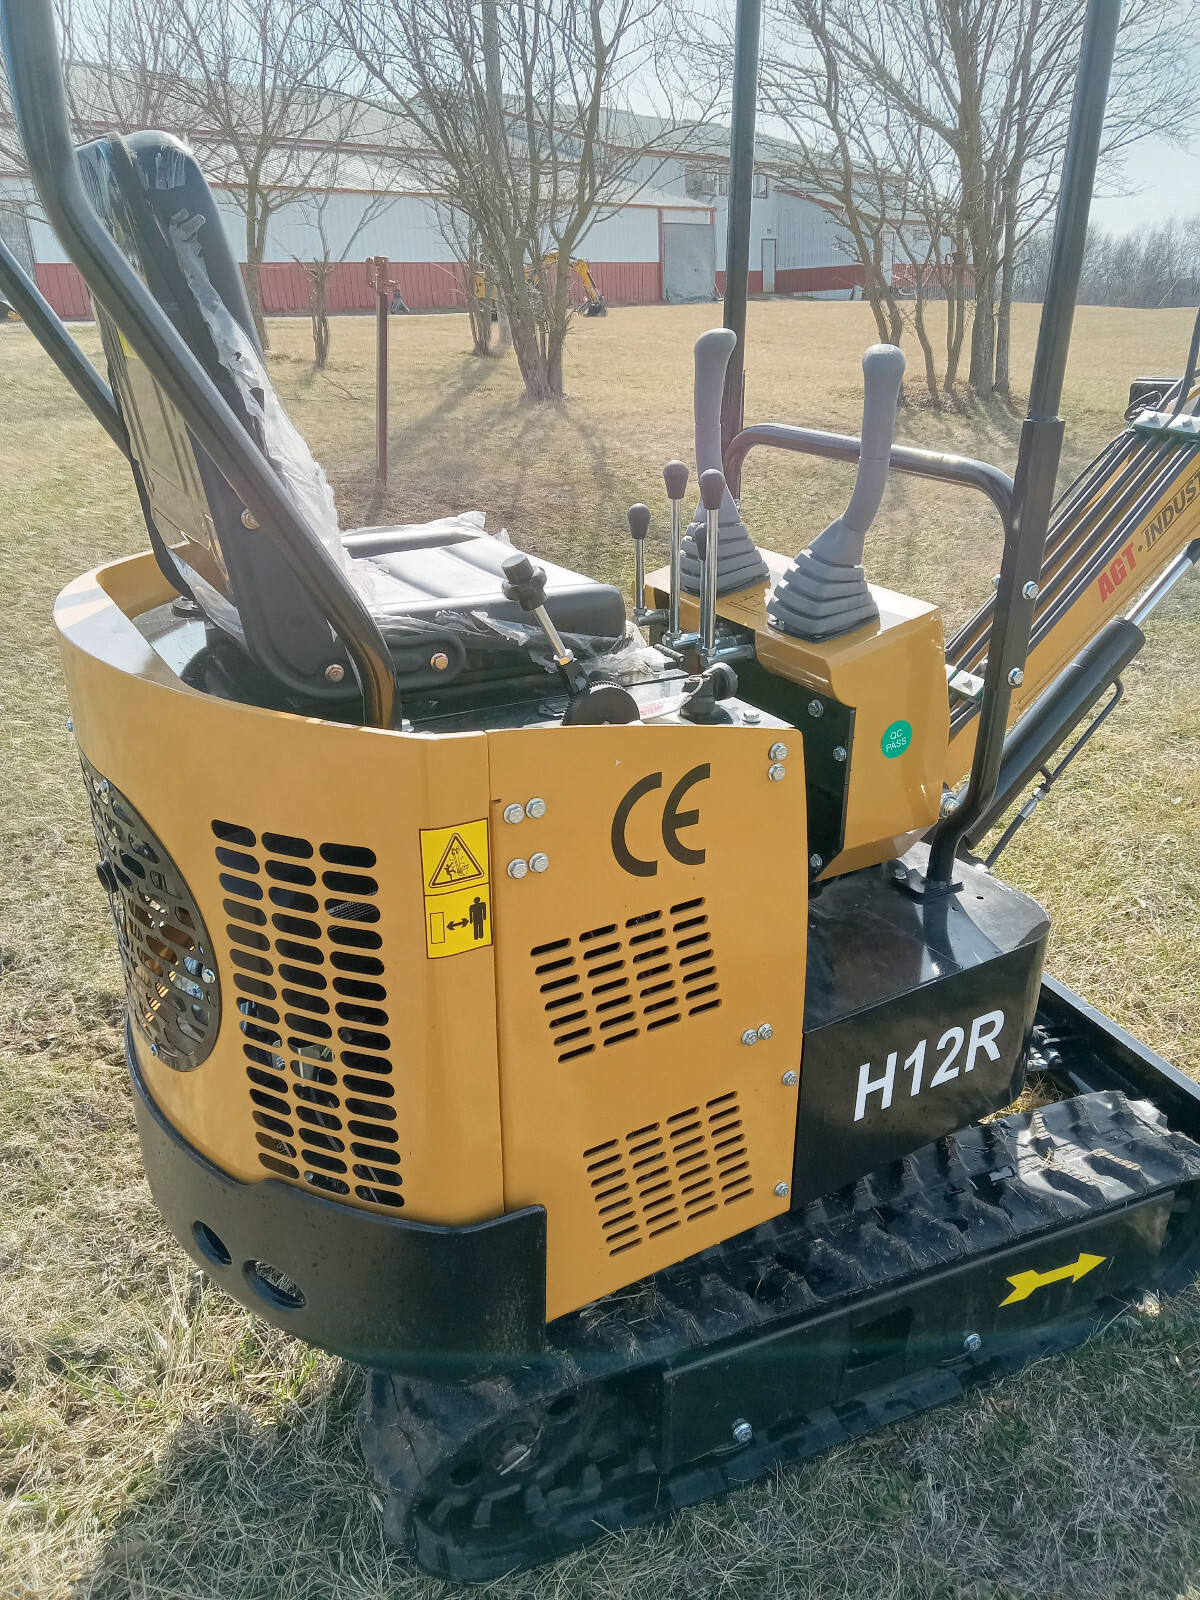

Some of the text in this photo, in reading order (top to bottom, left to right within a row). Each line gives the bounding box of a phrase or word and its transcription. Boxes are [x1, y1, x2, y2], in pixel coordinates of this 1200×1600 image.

[1097, 541, 1136, 603] AGT
[886, 737, 907, 752] PASS
[611, 763, 711, 877] CE
[853, 1009, 1005, 1122] H12R
